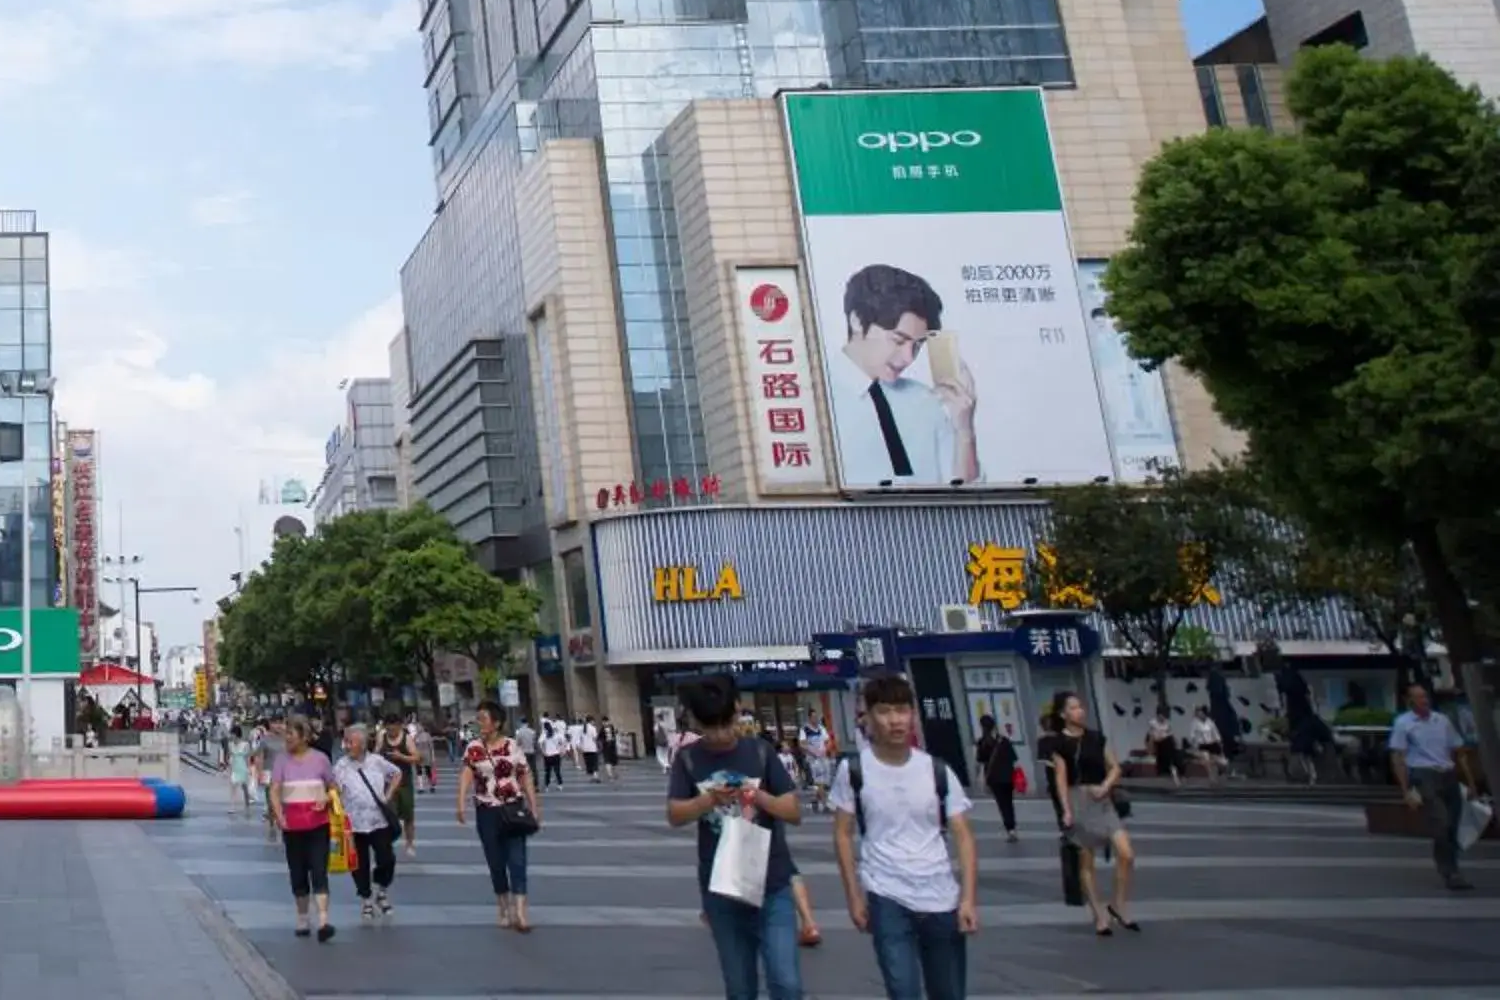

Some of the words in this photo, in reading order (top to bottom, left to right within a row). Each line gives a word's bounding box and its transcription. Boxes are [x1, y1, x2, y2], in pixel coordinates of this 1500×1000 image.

[965, 287, 1056, 303] 拍照更清晰
[757, 338, 811, 468] 石路国际
[654, 560, 743, 601] HLA
